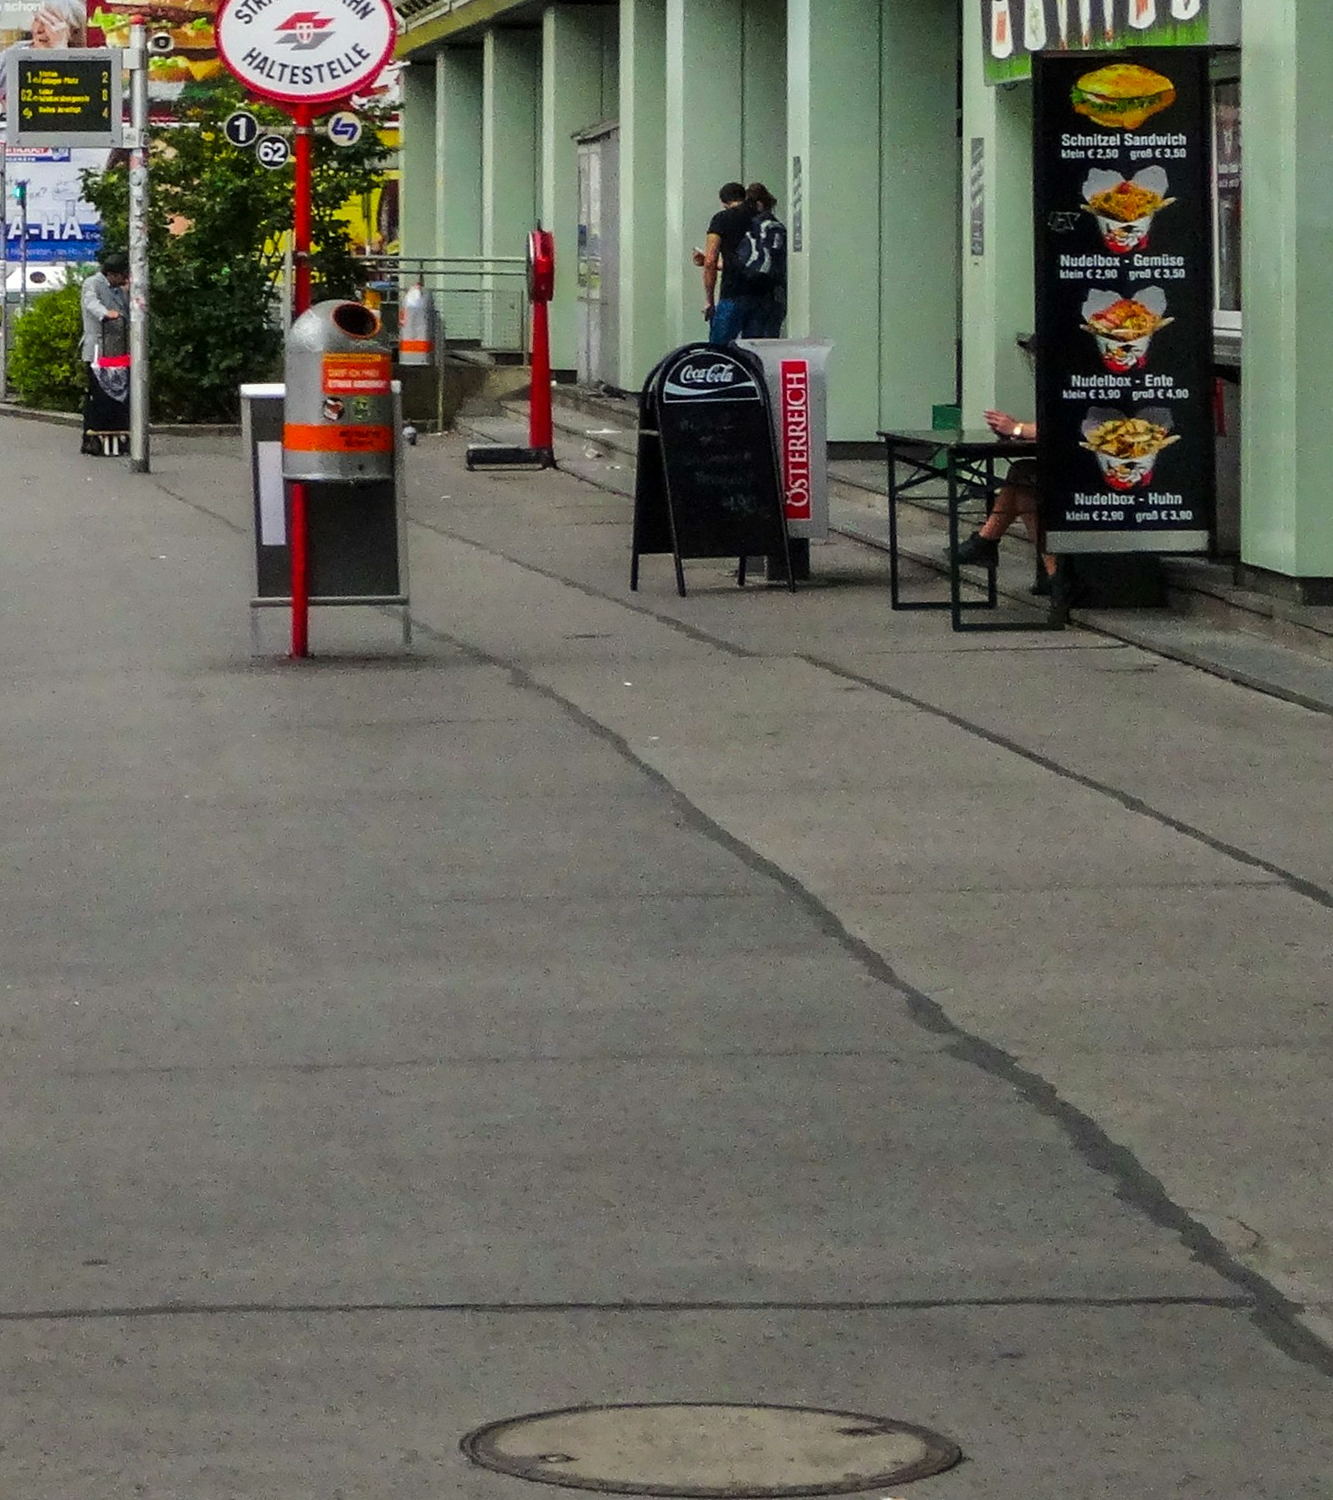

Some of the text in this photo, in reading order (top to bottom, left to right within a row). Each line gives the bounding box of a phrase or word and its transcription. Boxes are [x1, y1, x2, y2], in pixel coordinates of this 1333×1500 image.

[241, 43, 371, 85] HALTESTELLE
[27, 71, 32, 83] 1
[102, 71, 108, 83] 2
[234, 118, 246, 141] 1
[1061, 133, 1187, 147] Schnitzel Sandwich
[259, 142, 285, 162] 62
[1061, 149, 1085, 158] klein
[1060, 254, 1120, 267] Nudelbox
[1134, 254, 1184, 267] Gemüse
[1060, 269, 1083, 278] klein
[1071, 375, 1132, 387] Nudelbox
[1145, 374, 1174, 387] Ente
[1063, 390, 1086, 399] klein
[786, 372, 808, 507] ÖSTERREICH
[1074, 493, 1135, 505] Nudelbox
[1148, 492, 1182, 505] Huhn
[1066, 511, 1089, 520] klein
